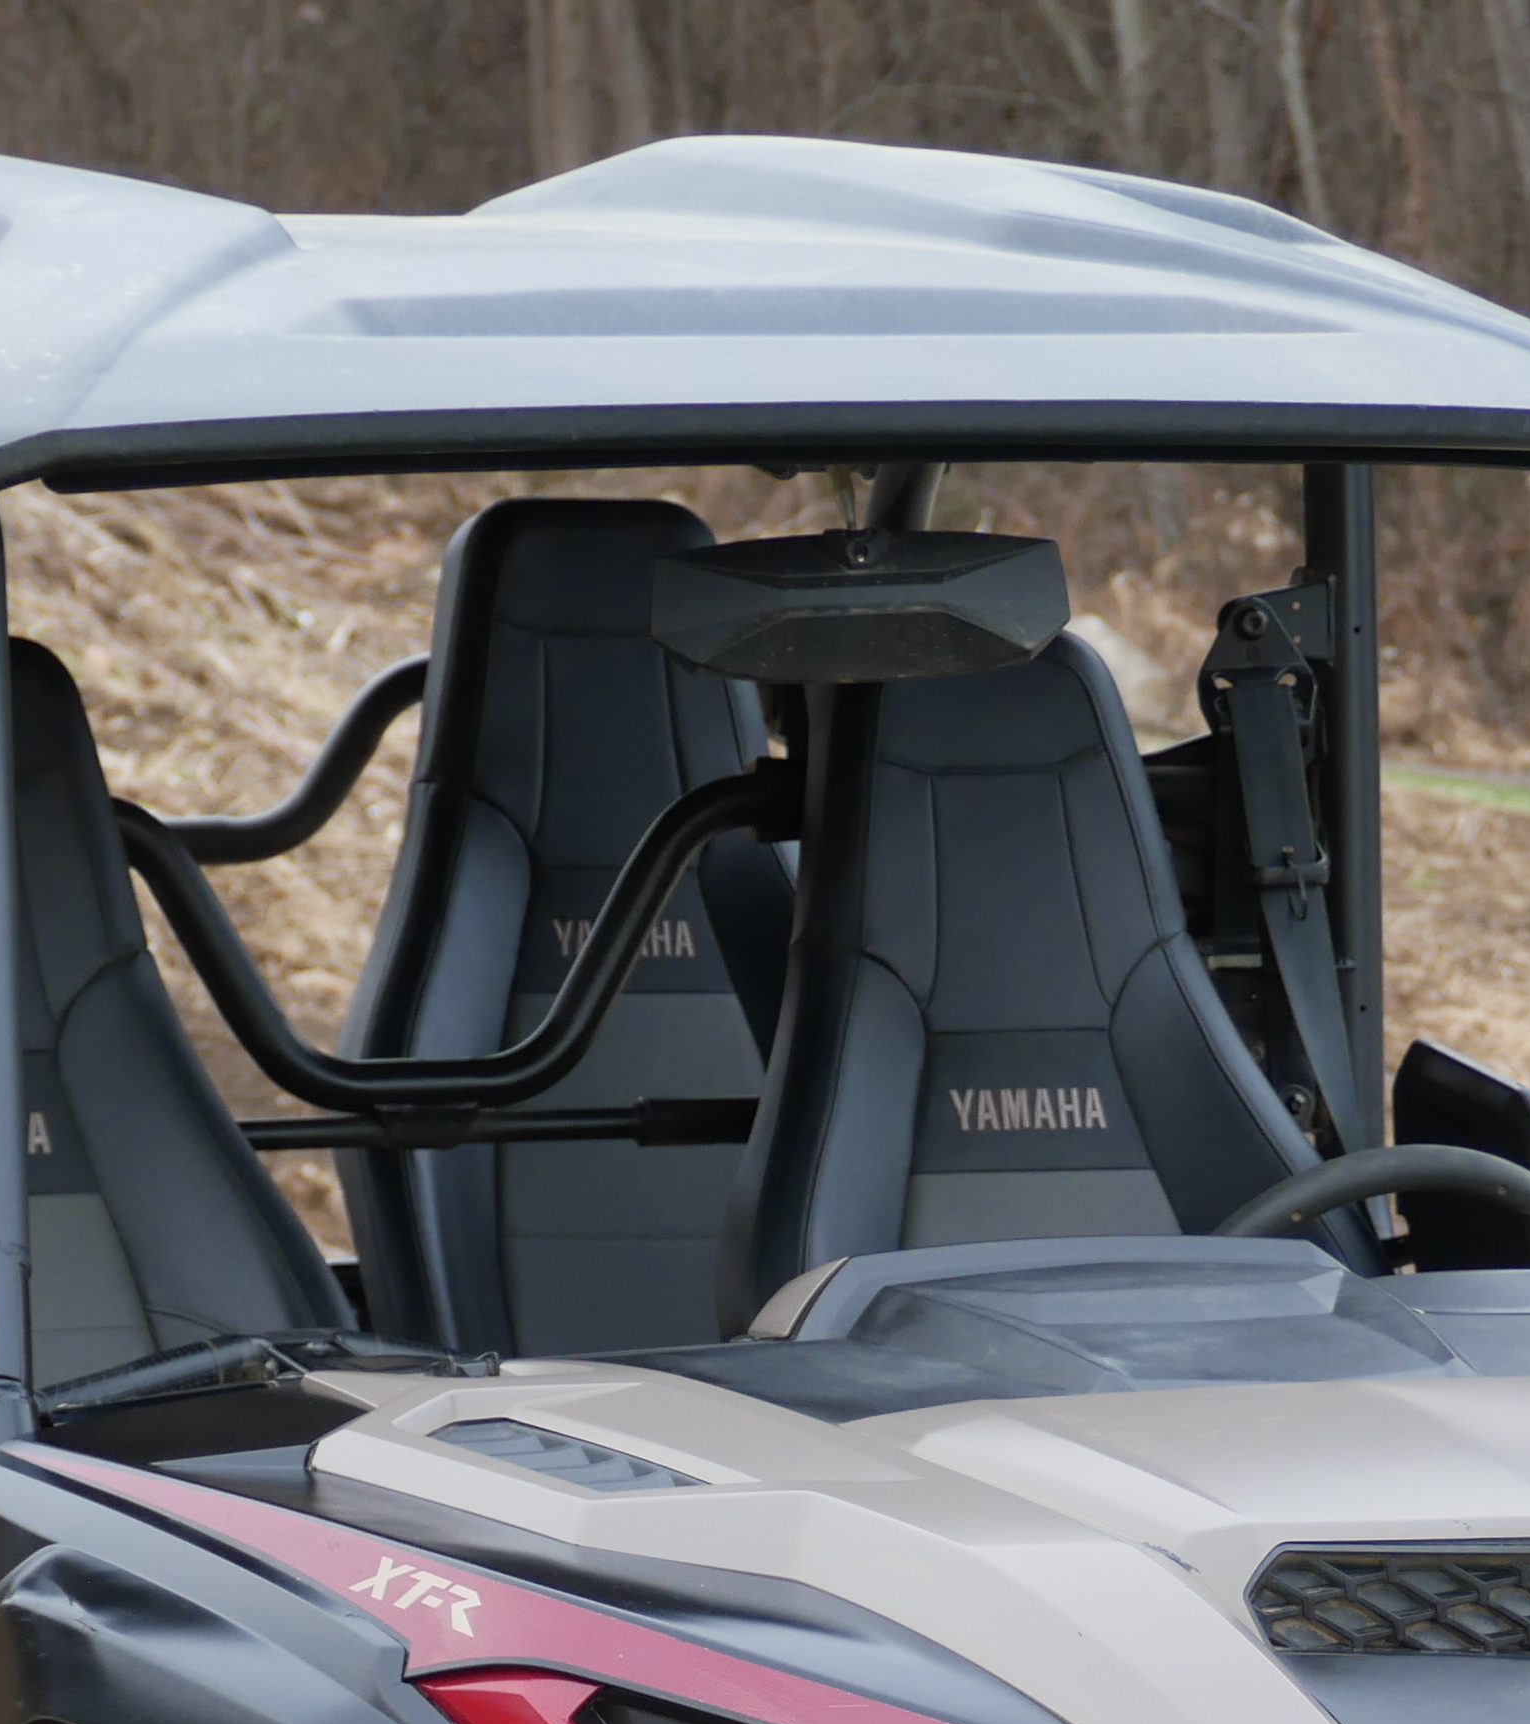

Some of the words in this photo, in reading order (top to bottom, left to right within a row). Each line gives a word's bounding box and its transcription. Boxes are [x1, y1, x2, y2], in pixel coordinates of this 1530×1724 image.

[551, 918, 696, 958] YAHA
[949, 1087, 1107, 1131] YAMAHA
[347, 1555, 482, 1638] XT-R
